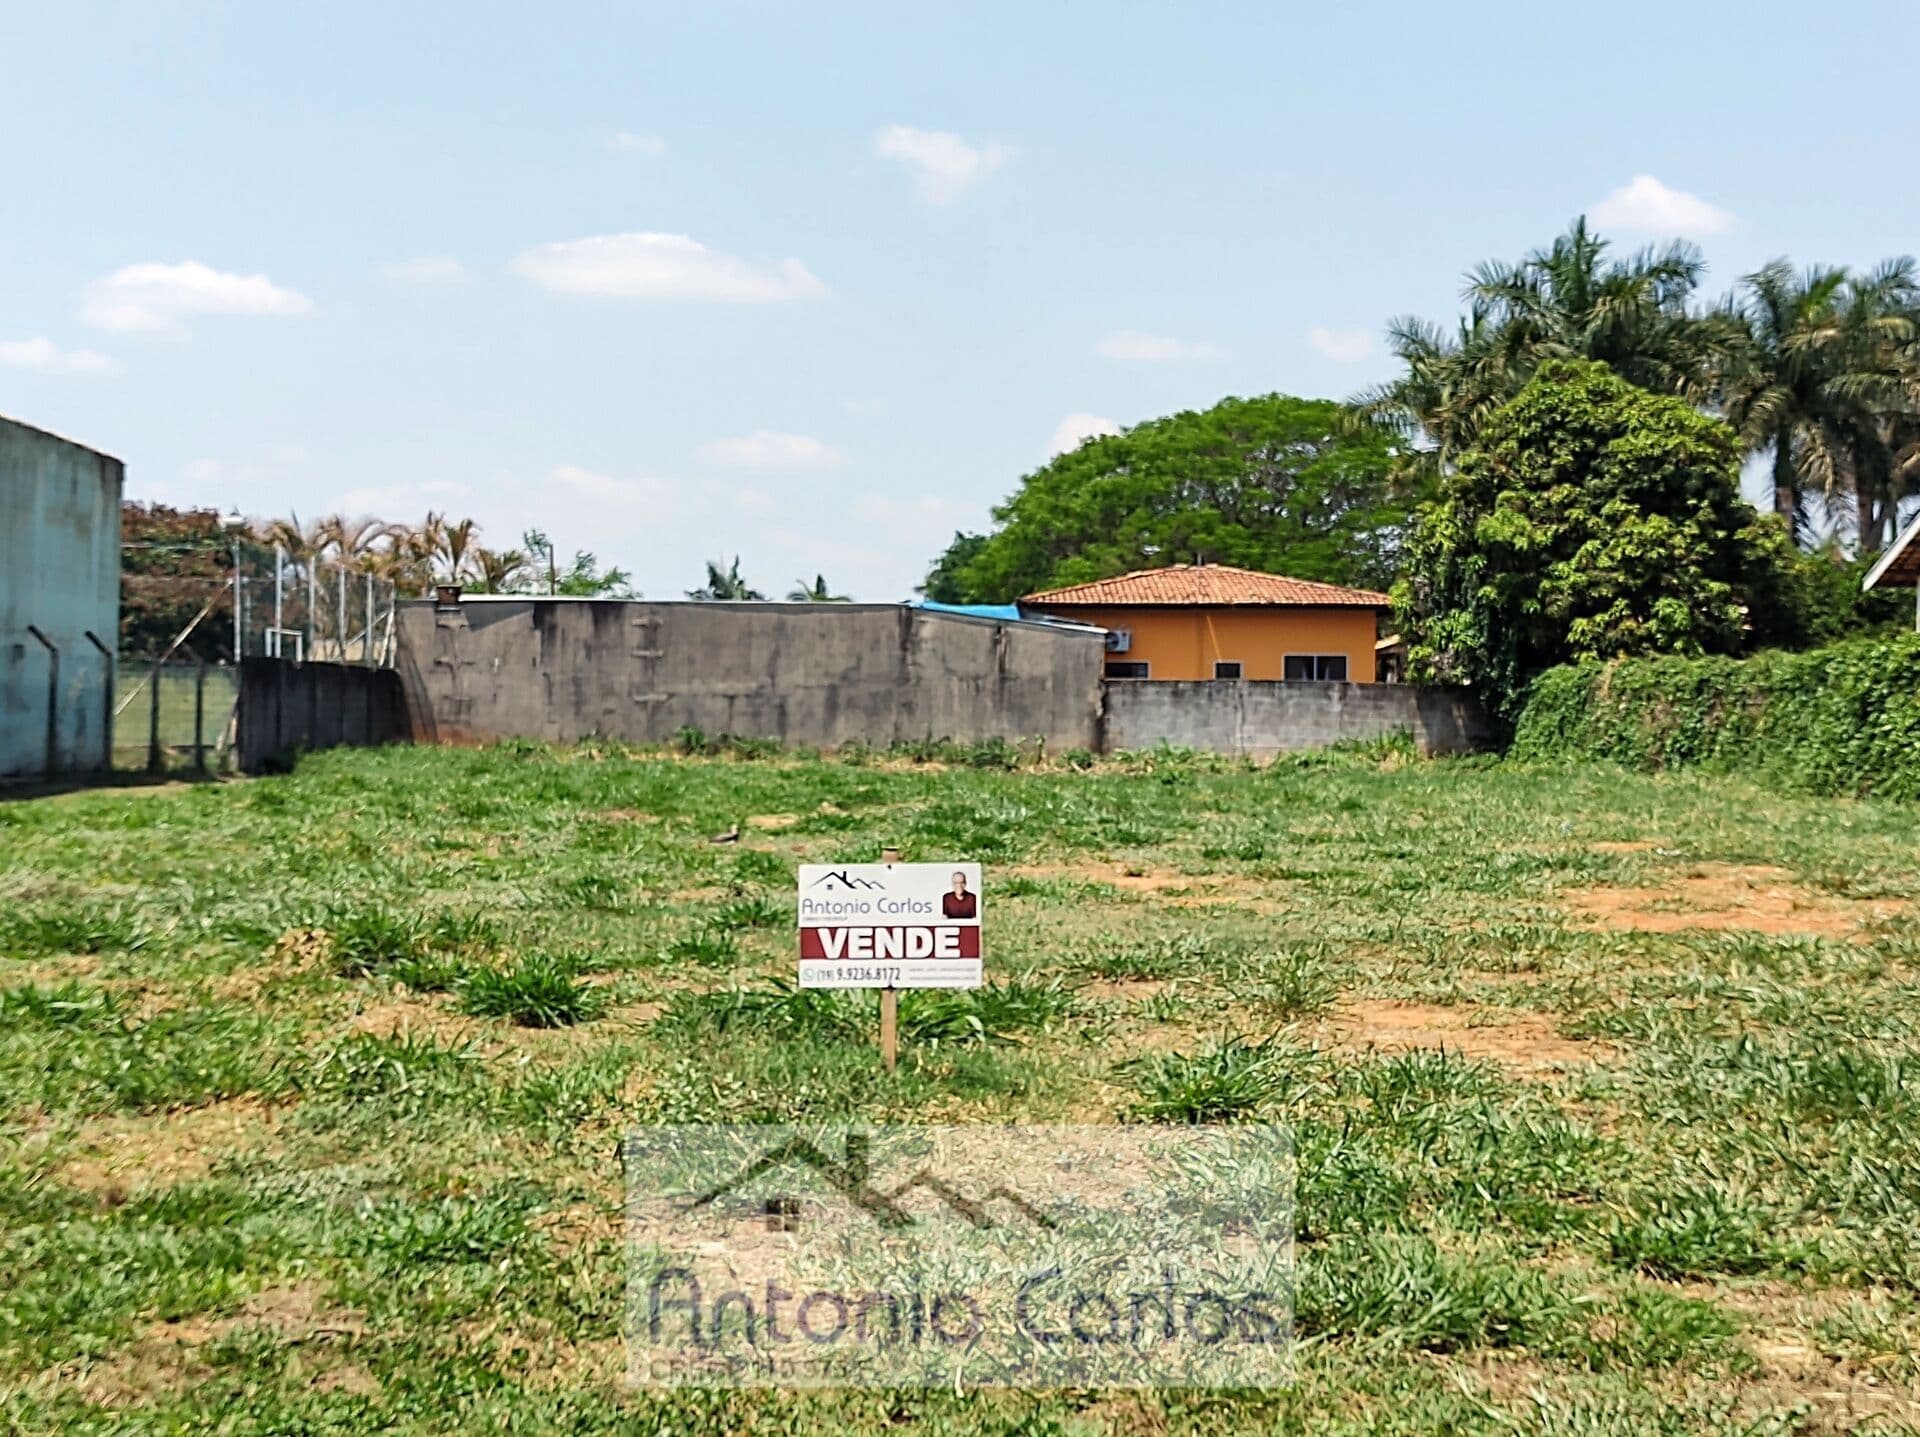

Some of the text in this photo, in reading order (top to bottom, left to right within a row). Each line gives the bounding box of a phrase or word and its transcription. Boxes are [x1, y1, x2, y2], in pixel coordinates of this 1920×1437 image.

[802, 897, 933, 914] Antonio Carlos
[817, 927, 961, 959] VENDE
[837, 967, 901, 980] 9.9236.8172
